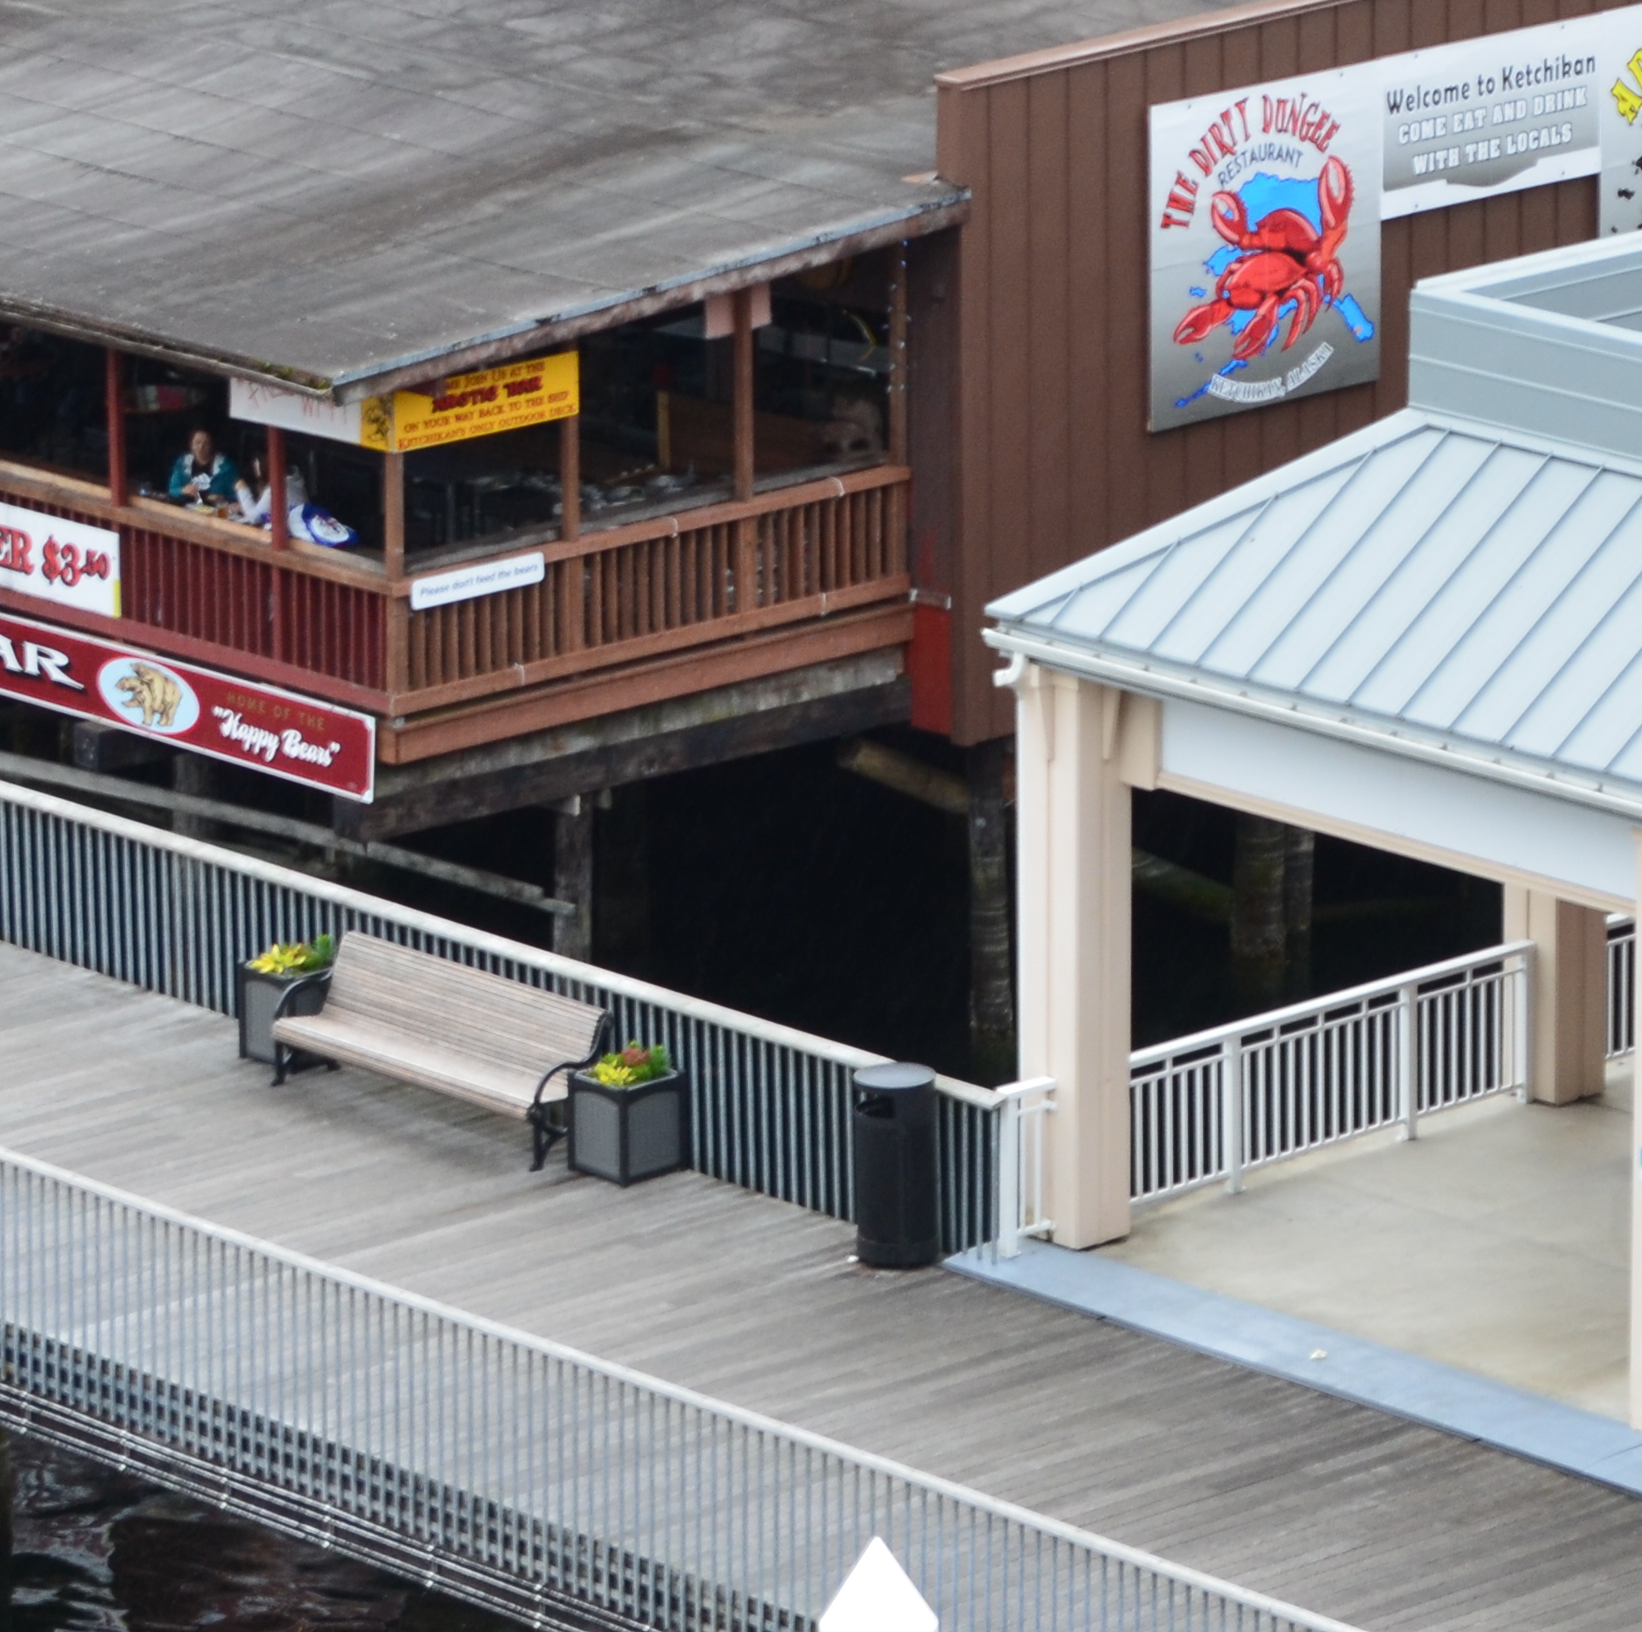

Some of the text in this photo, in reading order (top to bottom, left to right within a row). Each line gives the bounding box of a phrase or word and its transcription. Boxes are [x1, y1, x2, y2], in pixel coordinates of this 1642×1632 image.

[1386, 53, 1596, 115] Welcome to Ketchikan
[1397, 85, 1588, 145] COME EAT AND DRINK
[1160, 92, 1342, 229] THE DIRTY DUNGEE
[1217, 142, 1304, 189] RESTAURANT
[1412, 121, 1573, 176] WITH THE LOCALS
[432, 376, 543, 414] ARCTIC BAR
[464, 373, 488, 389] JOIN
[492, 369, 506, 381] US
[526, 362, 546, 375] THE
[404, 390, 570, 434] ON YOUR WAY BACK TO THE SHIP
[469, 421, 495, 436] ONLY
[498, 411, 546, 429] OUTDOOR
[549, 404, 577, 419] DECK
[420, 564, 539, 596] Please don't feed the bears
[227, 691, 325, 731] HOME OF THE
